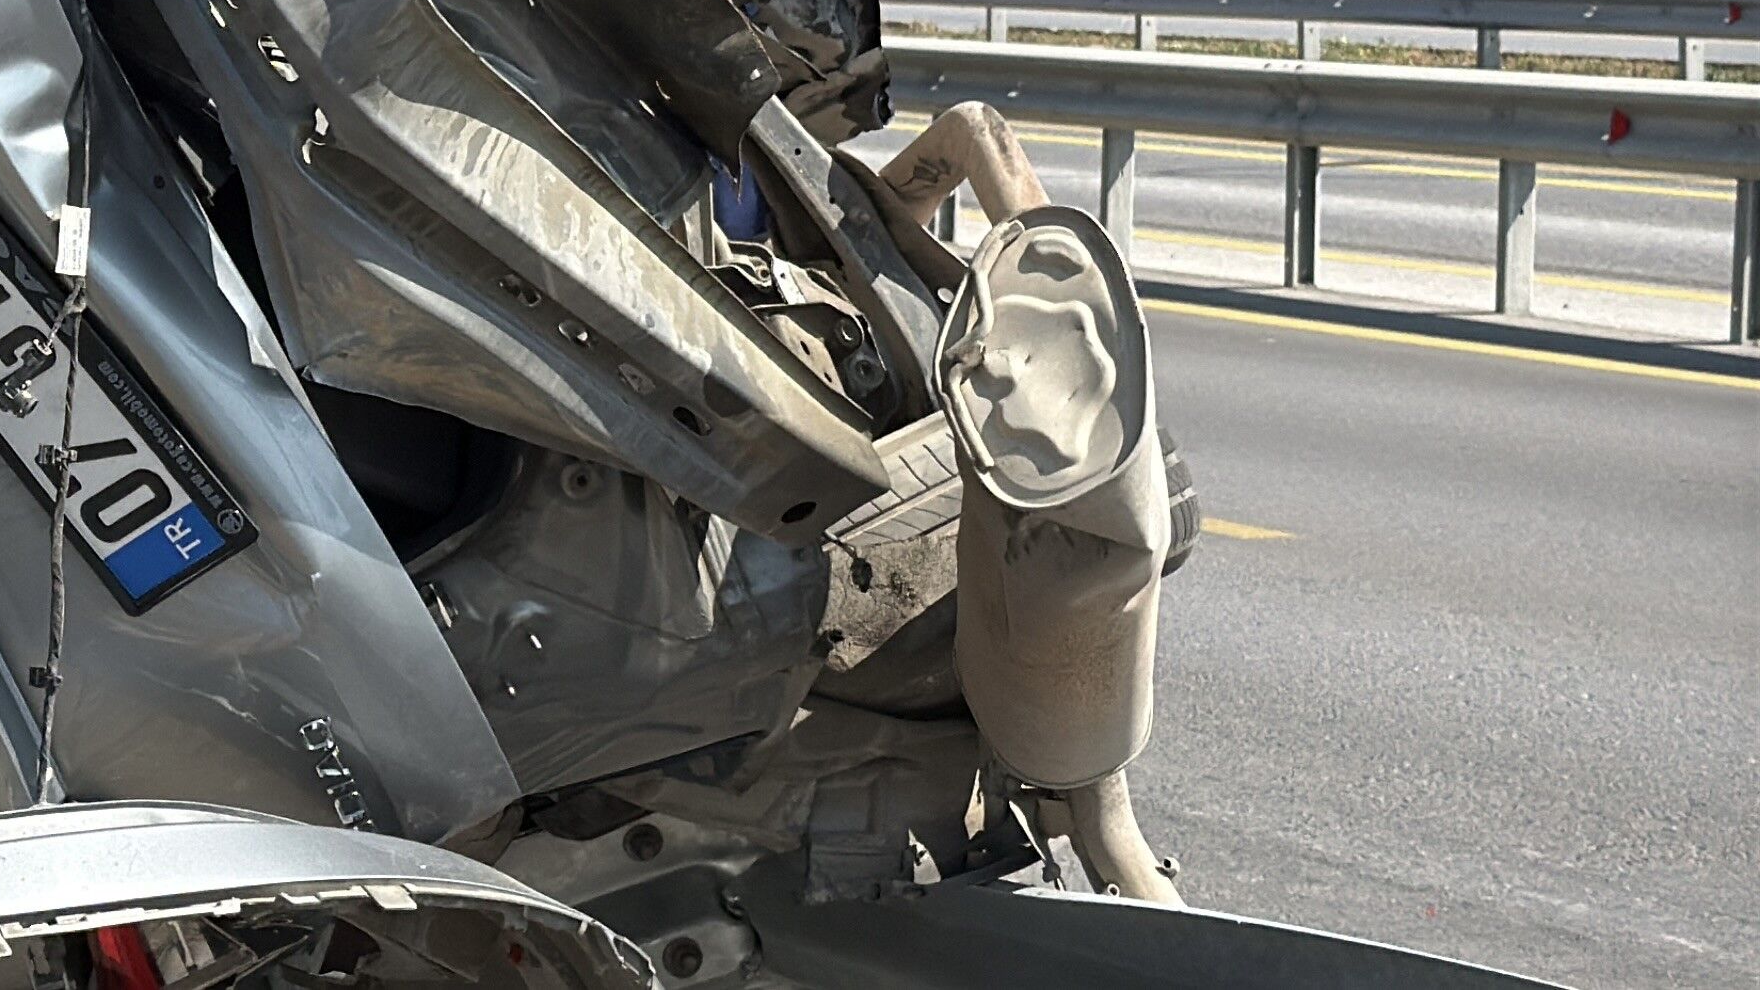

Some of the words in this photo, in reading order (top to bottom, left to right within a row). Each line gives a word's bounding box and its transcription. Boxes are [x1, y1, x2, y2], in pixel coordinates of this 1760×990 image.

[34, 438, 173, 544] 07
[163, 516, 201, 561] TR
[298, 716, 373, 831] DIAQ
